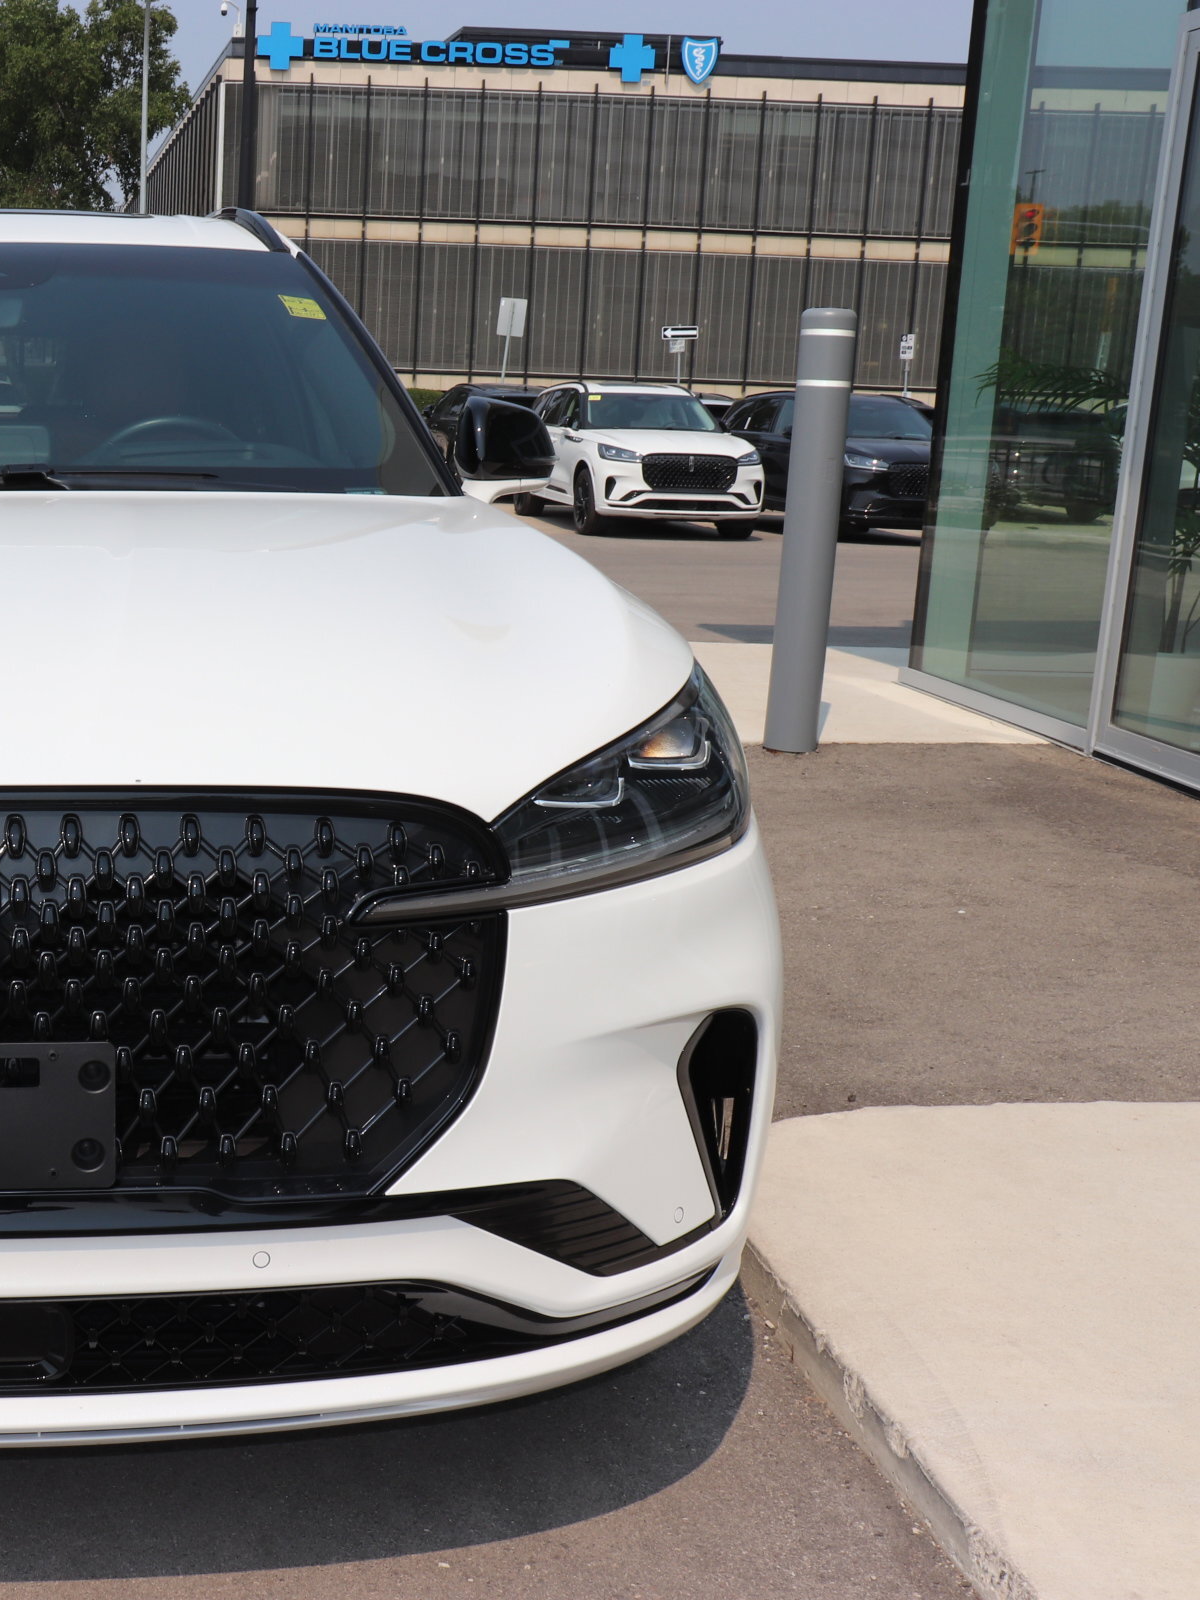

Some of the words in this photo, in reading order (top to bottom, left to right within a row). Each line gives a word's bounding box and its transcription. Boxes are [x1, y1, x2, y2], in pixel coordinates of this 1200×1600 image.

[313, 23, 408, 36] MANITOBA
[313, 36, 413, 61] BLUE
[420, 40, 556, 66] CROSS
